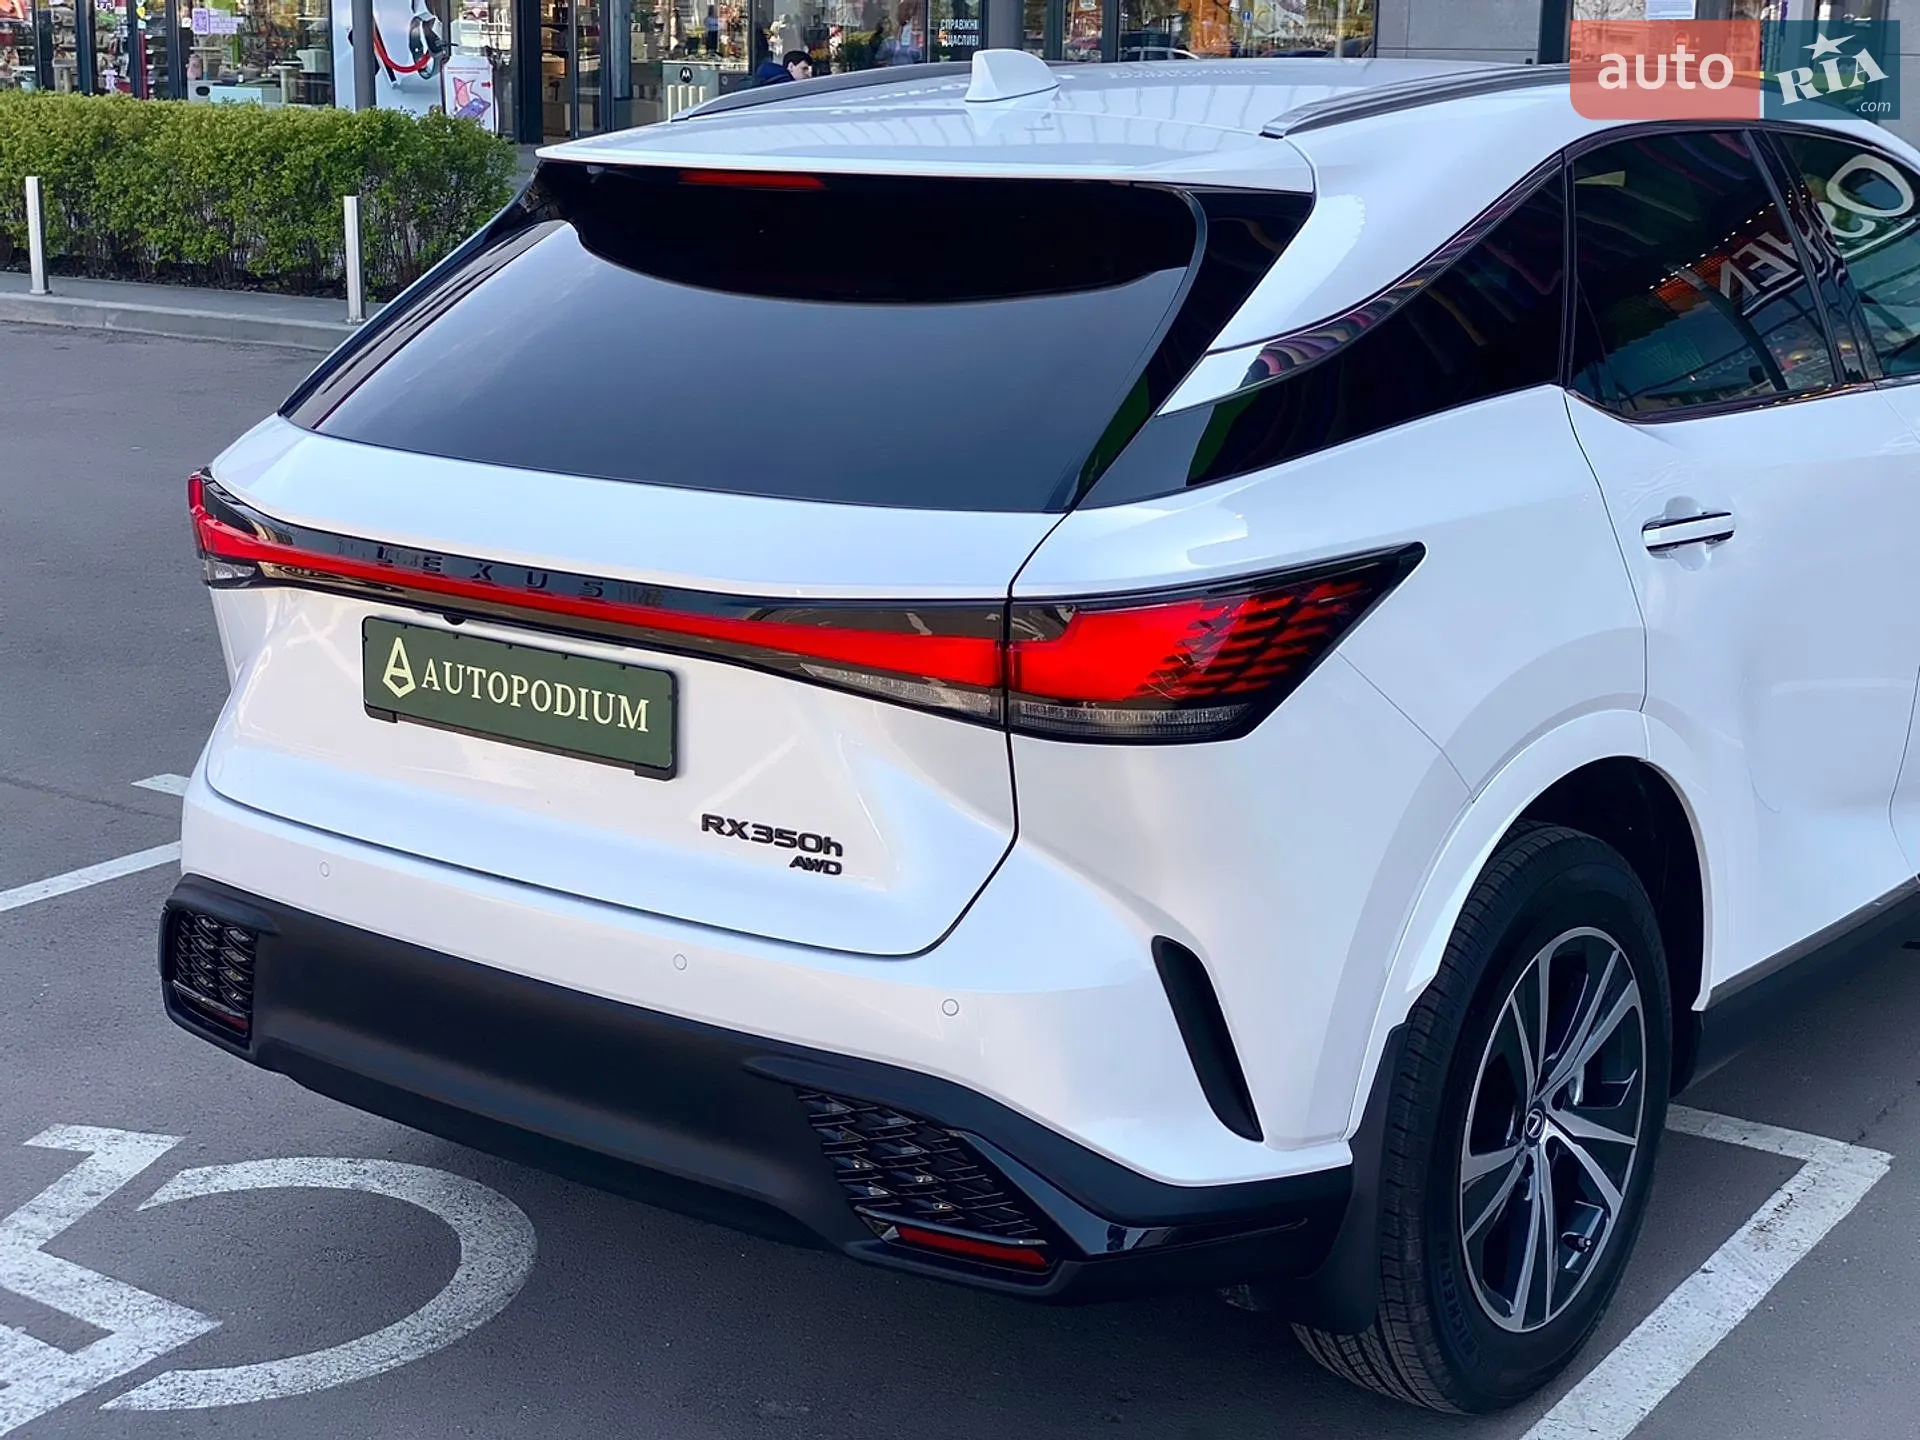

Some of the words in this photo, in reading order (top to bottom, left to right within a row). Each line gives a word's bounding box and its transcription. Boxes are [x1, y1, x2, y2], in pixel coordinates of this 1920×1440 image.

[376, 545, 604, 599] LEXUS
[421, 657, 649, 732] AUTOPODIUM
[701, 813, 843, 857] RX350h
[789, 855, 843, 876] AWD
